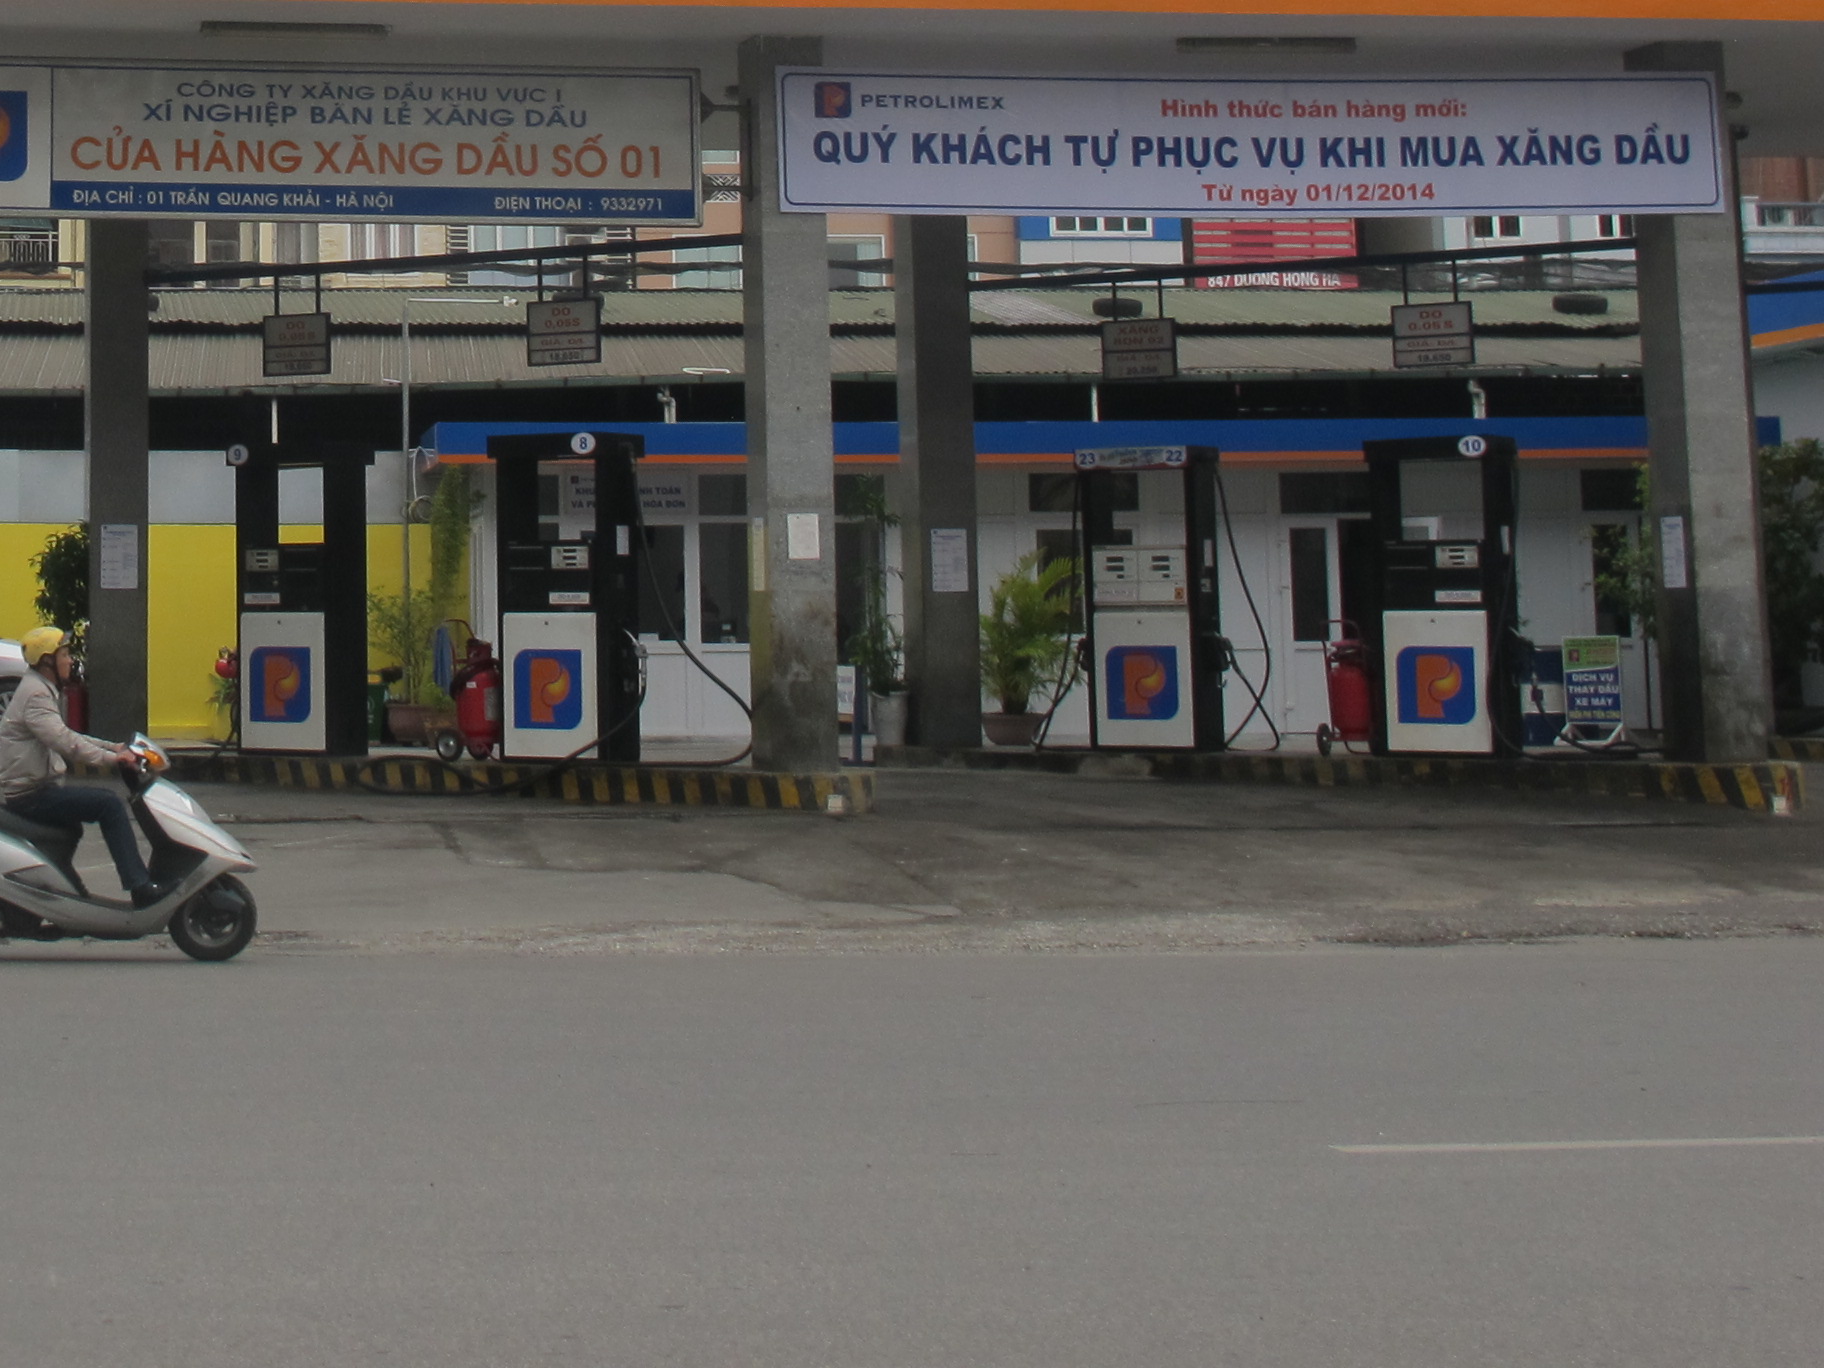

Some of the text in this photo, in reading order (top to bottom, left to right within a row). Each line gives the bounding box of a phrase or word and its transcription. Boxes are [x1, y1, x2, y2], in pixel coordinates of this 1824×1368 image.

[176, 80, 256, 99] CÔNG
[265, 84, 294, 99] TY
[301, 81, 375, 101] XĂNG
[440, 86, 488, 103] KHU
[555, 88, 562, 103] I
[861, 93, 1005, 110] PETROLIMEX
[143, 99, 174, 122] XÍ
[182, 101, 298, 127] NGHIỆP
[422, 104, 515, 128] XĂNG
[1160, 98, 1467, 123] Hình thức bán hàng mới:
[70, 126, 662, 179] CỬA HÀNG XĂNG DẦU SỐ 01
[813, 123, 1691, 175] QUÝ KHÁCH TỰ PHỤC VỤ KHI MUA XĂNG DẦU
[72, 188, 101, 206] ĐỊA
[146, 190, 165, 205] 01
[217, 191, 279, 207] QUANG
[336, 189, 358, 208] HÀ
[362, 191, 394, 212] NỘI
[1202, 182, 1435, 206] Từ ngày 01/12/2014
[494, 195, 531, 213] ĐIỆN
[534, 196, 582, 213] THOẠI
[599, 196, 663, 212] 9332971
[551, 307, 571, 317] DO
[1419, 310, 1443, 319] DO
[579, 436, 588, 451] 8
[1462, 439, 1482, 453] 10
[233, 448, 242, 461] 9
[1078, 452, 1095, 466] 23
[1165, 449, 1183, 463] 22
